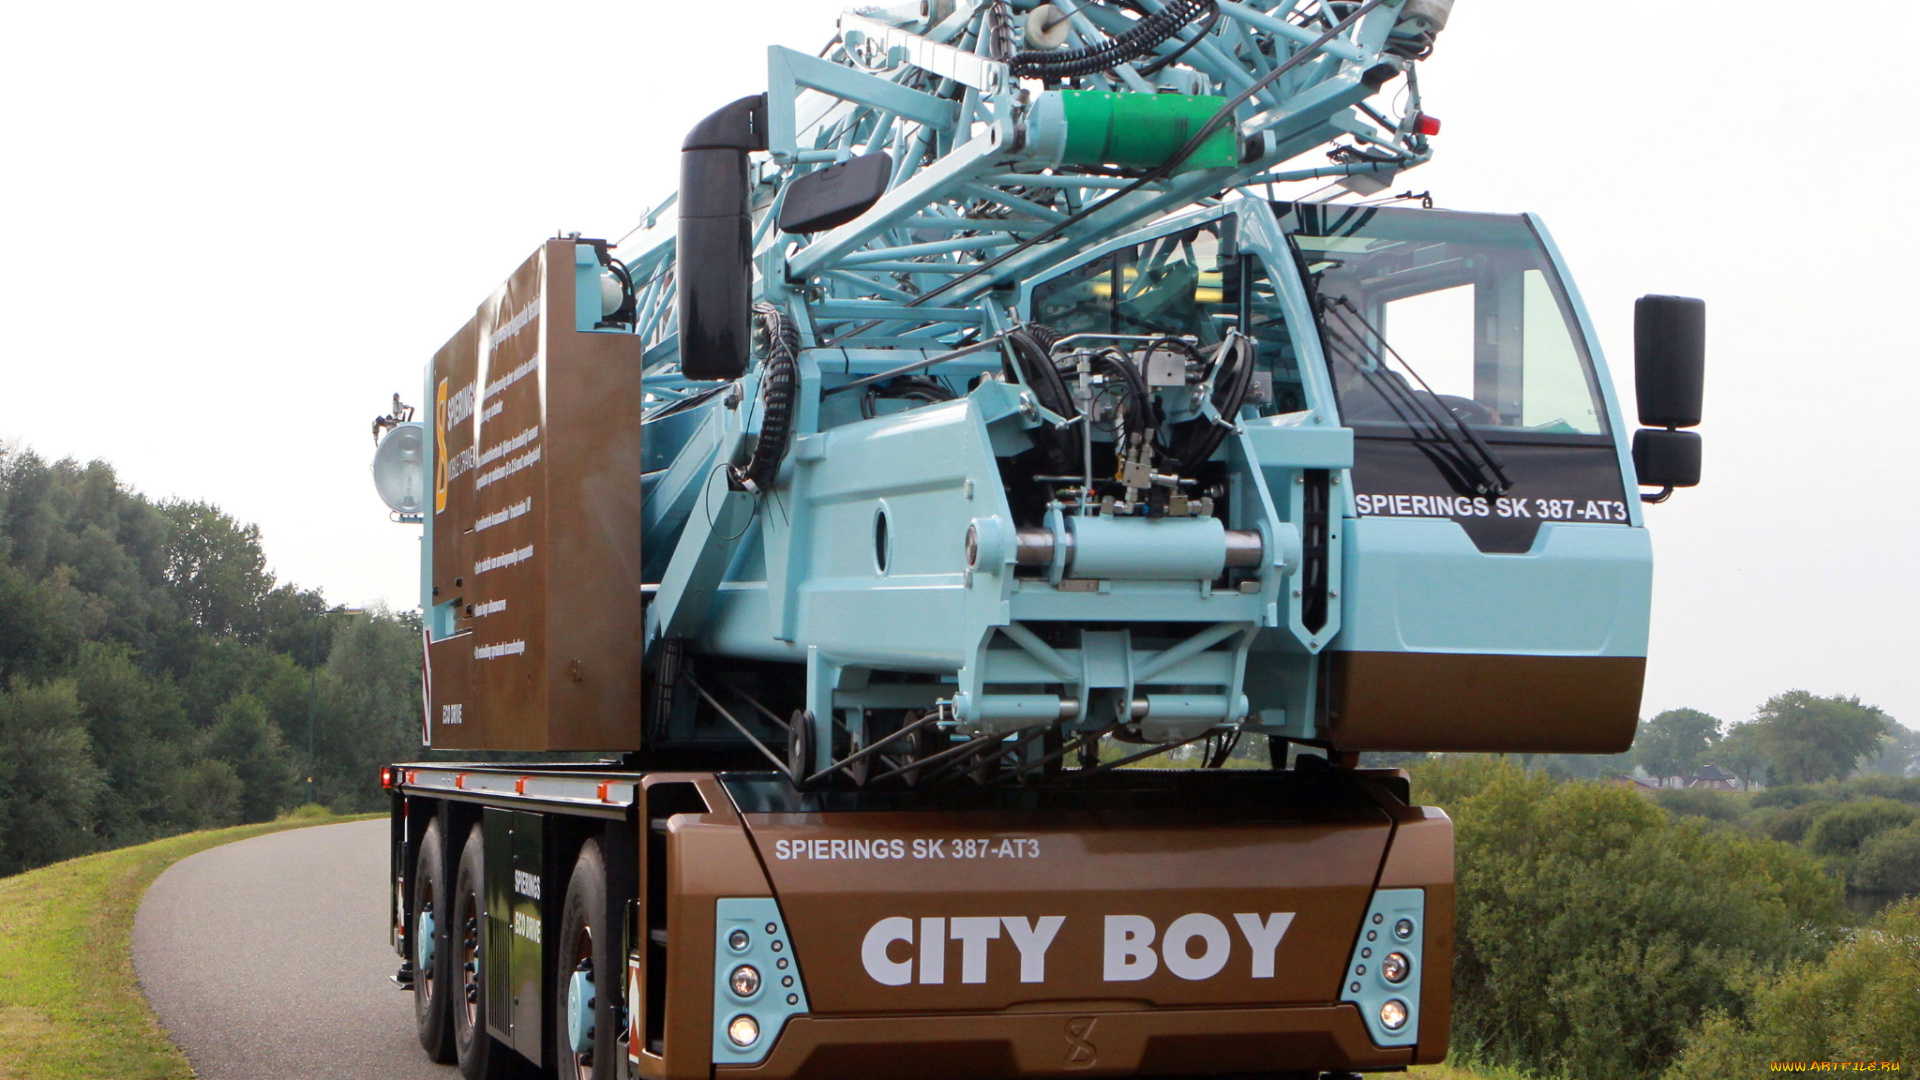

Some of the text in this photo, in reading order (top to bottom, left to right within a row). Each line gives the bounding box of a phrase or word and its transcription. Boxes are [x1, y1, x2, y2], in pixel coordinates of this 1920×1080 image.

[1356, 494, 1627, 521] SPIERINGS SK 387-AT3
[775, 838, 1040, 860] SPIERINGS SK 387-AT3
[514, 869, 541, 901] SPIERINGS
[515, 911, 542, 944] ECO DRIVE
[861, 911, 1297, 986] CITY BOY
